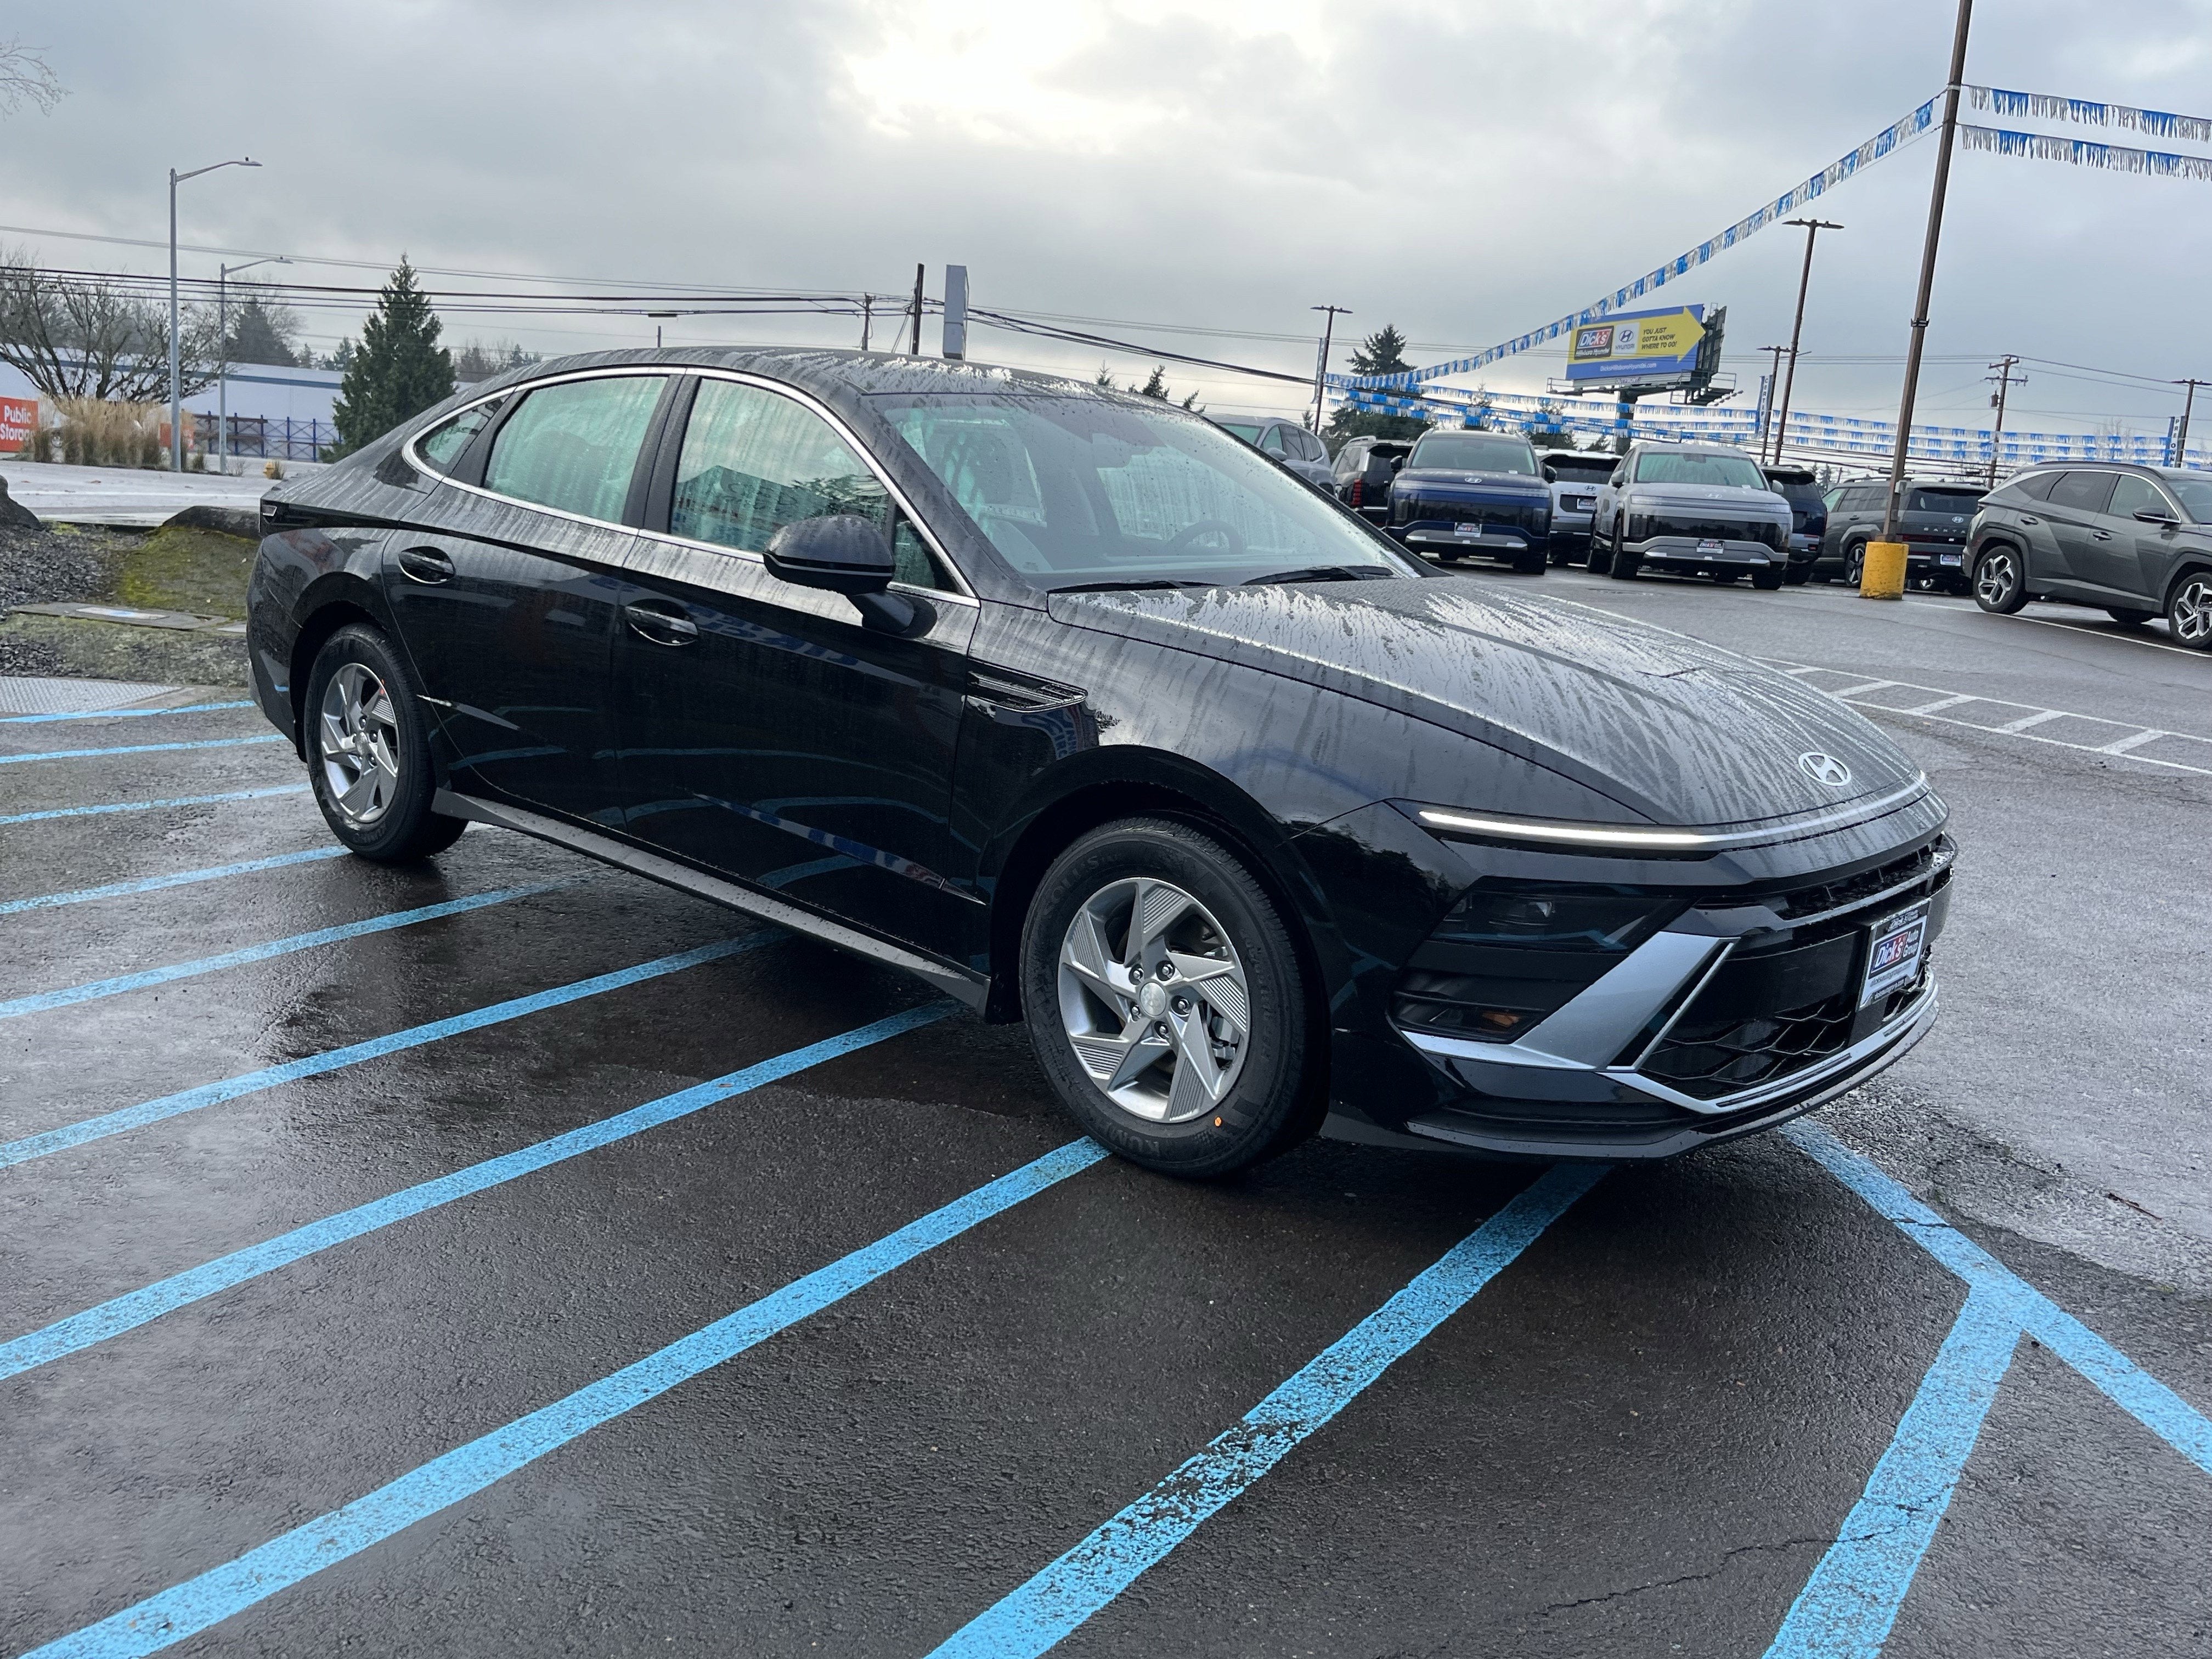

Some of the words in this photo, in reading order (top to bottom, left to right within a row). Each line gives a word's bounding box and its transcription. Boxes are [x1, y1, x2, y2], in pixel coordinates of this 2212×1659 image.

[1579, 331, 1607, 346] Dick's
[4, 405, 32, 424] Public
[1907, 930, 1919, 943] Auto
[1875, 937, 1904, 968] Dick's
[1903, 943, 1918, 957] Group
